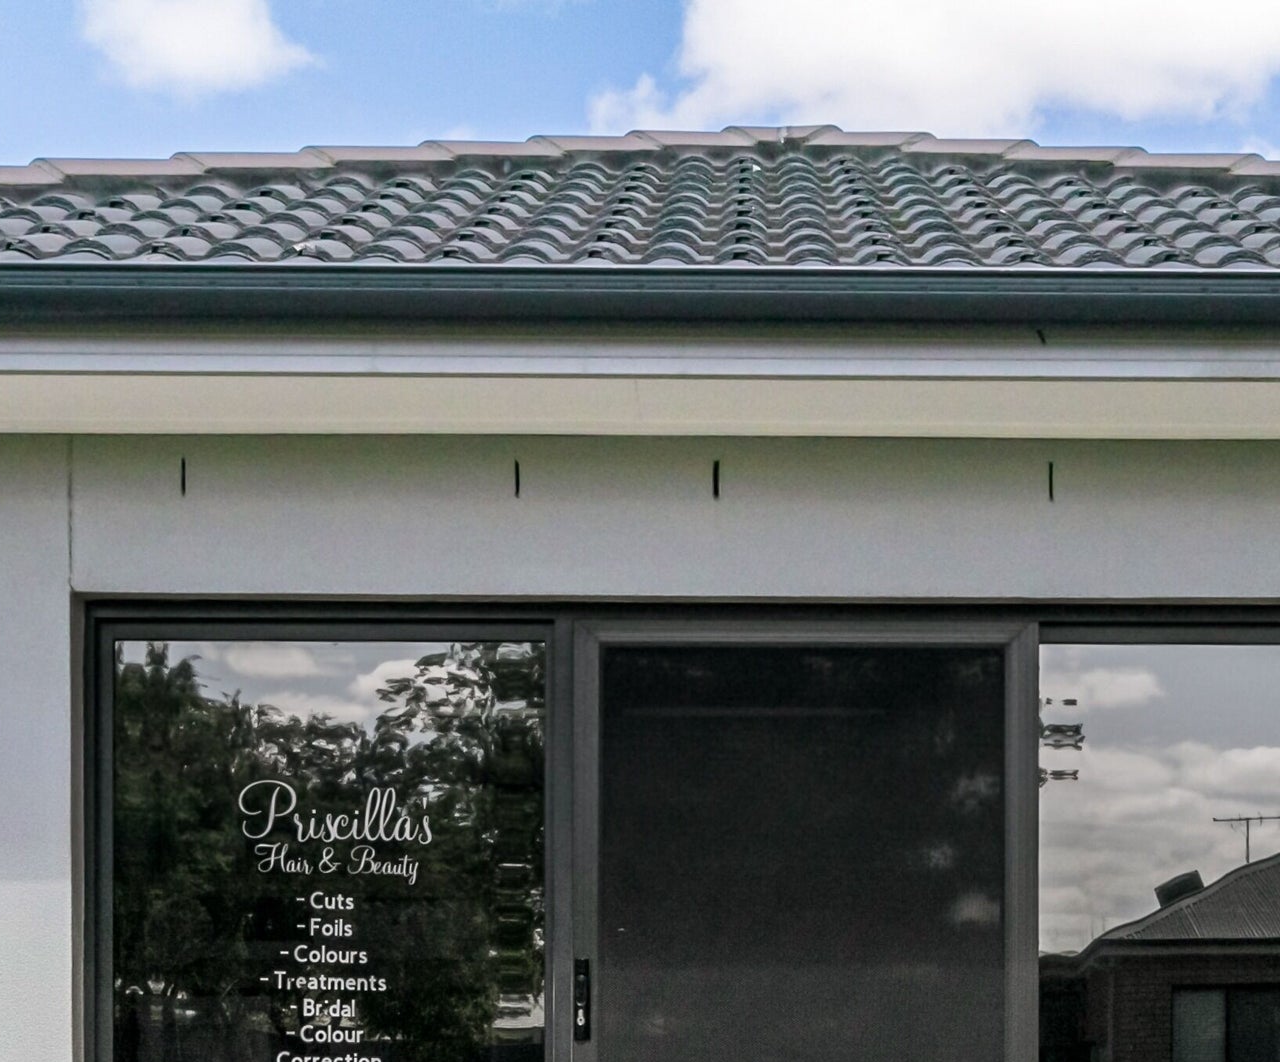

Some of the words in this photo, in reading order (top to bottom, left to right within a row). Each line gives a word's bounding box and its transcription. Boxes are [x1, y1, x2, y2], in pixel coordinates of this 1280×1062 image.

[238, 779, 433, 845] Priscilla's
[254, 842, 313, 875] Hair
[319, 847, 341, 874] &
[347, 845, 419, 886] Beauty
[310, 891, 355, 910] Cuts
[310, 917, 353, 937] Foils
[293, 944, 368, 964] Colours
[274, 970, 387, 992] Treatments
[300, 1025, 365, 1043] Colour
